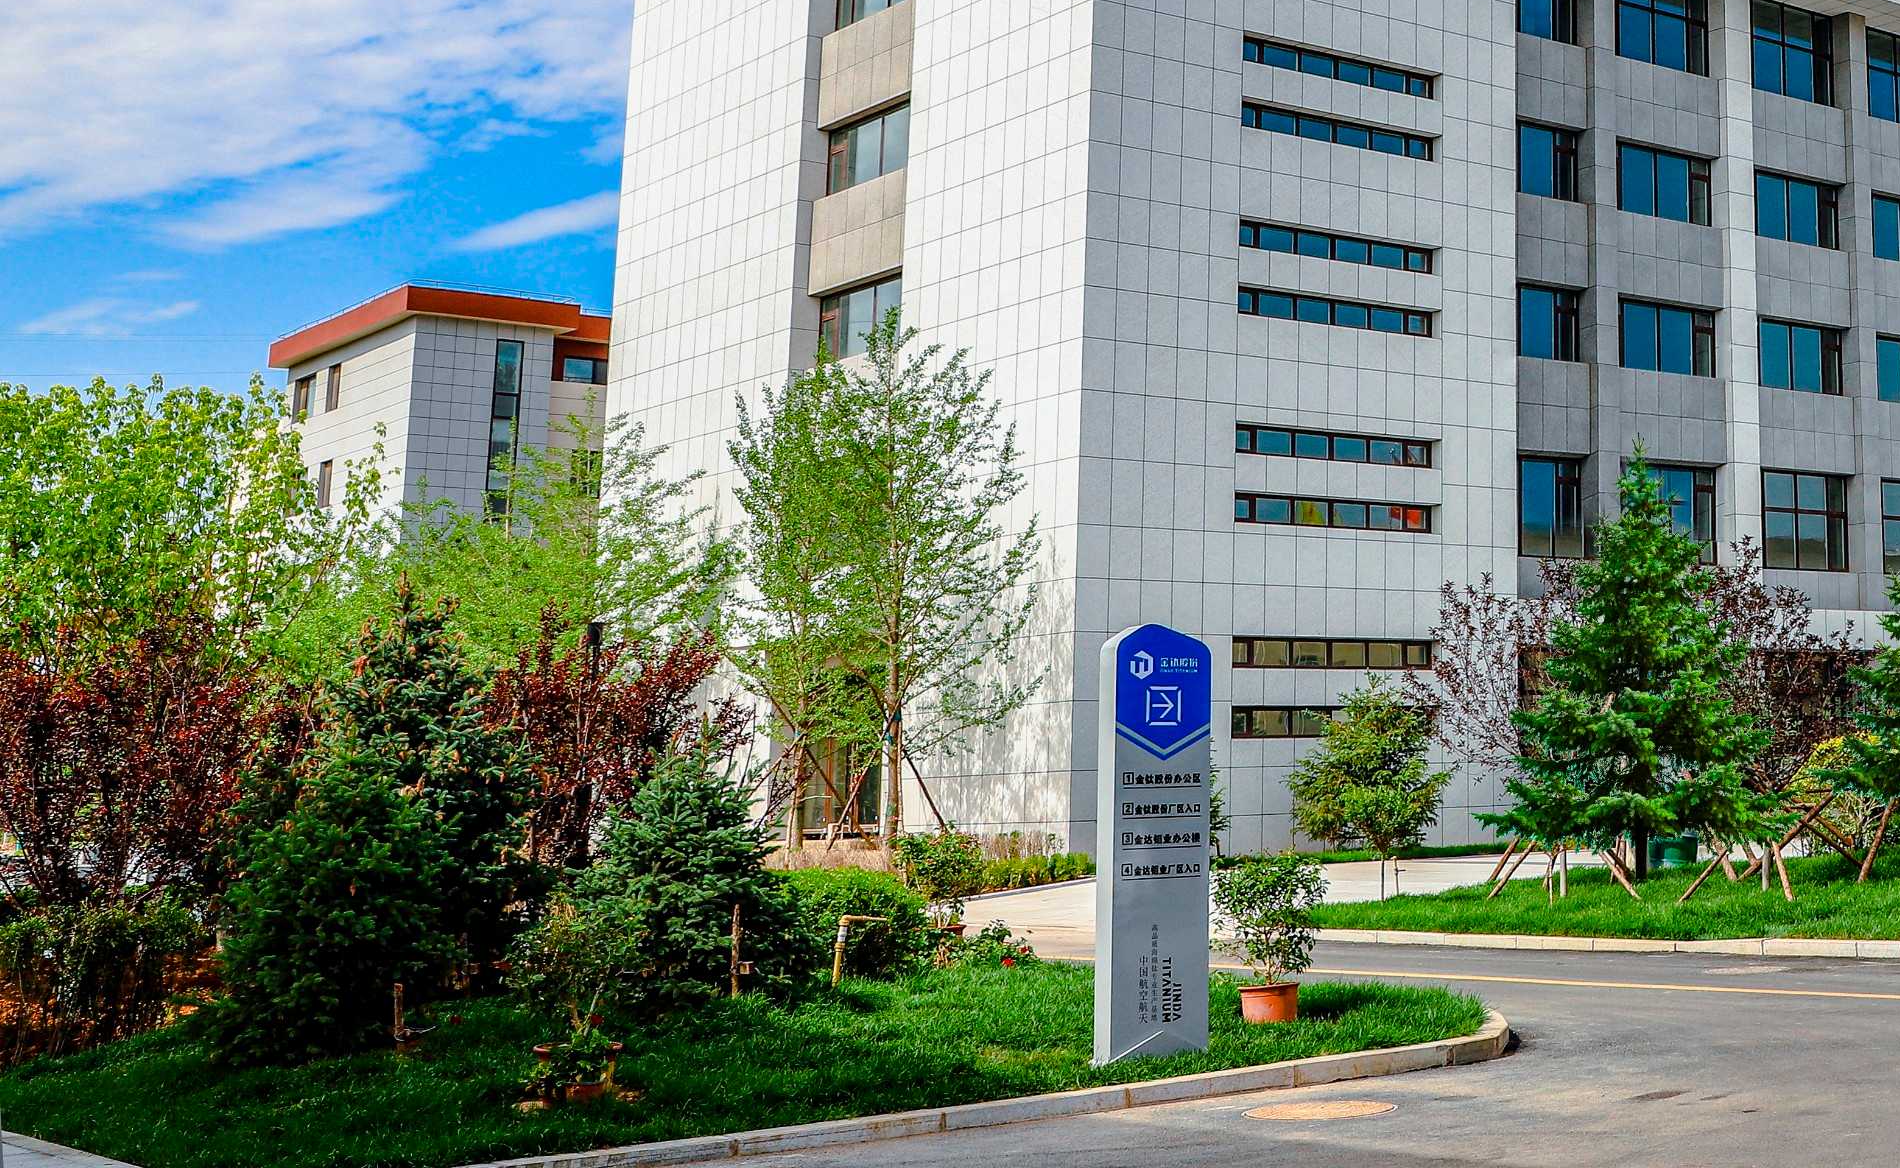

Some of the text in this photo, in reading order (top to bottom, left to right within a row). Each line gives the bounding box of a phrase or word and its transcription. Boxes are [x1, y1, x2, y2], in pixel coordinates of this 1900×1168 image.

[1135, 773, 1201, 785] 金钛股份办公区
[1134, 803, 1201, 815] 金钛股份厂区入口
[1138, 954, 1148, 1024] 中国航空航天
[1162, 956, 1172, 1023] TITANIUM
[1172, 982, 1182, 1022] JINDA
